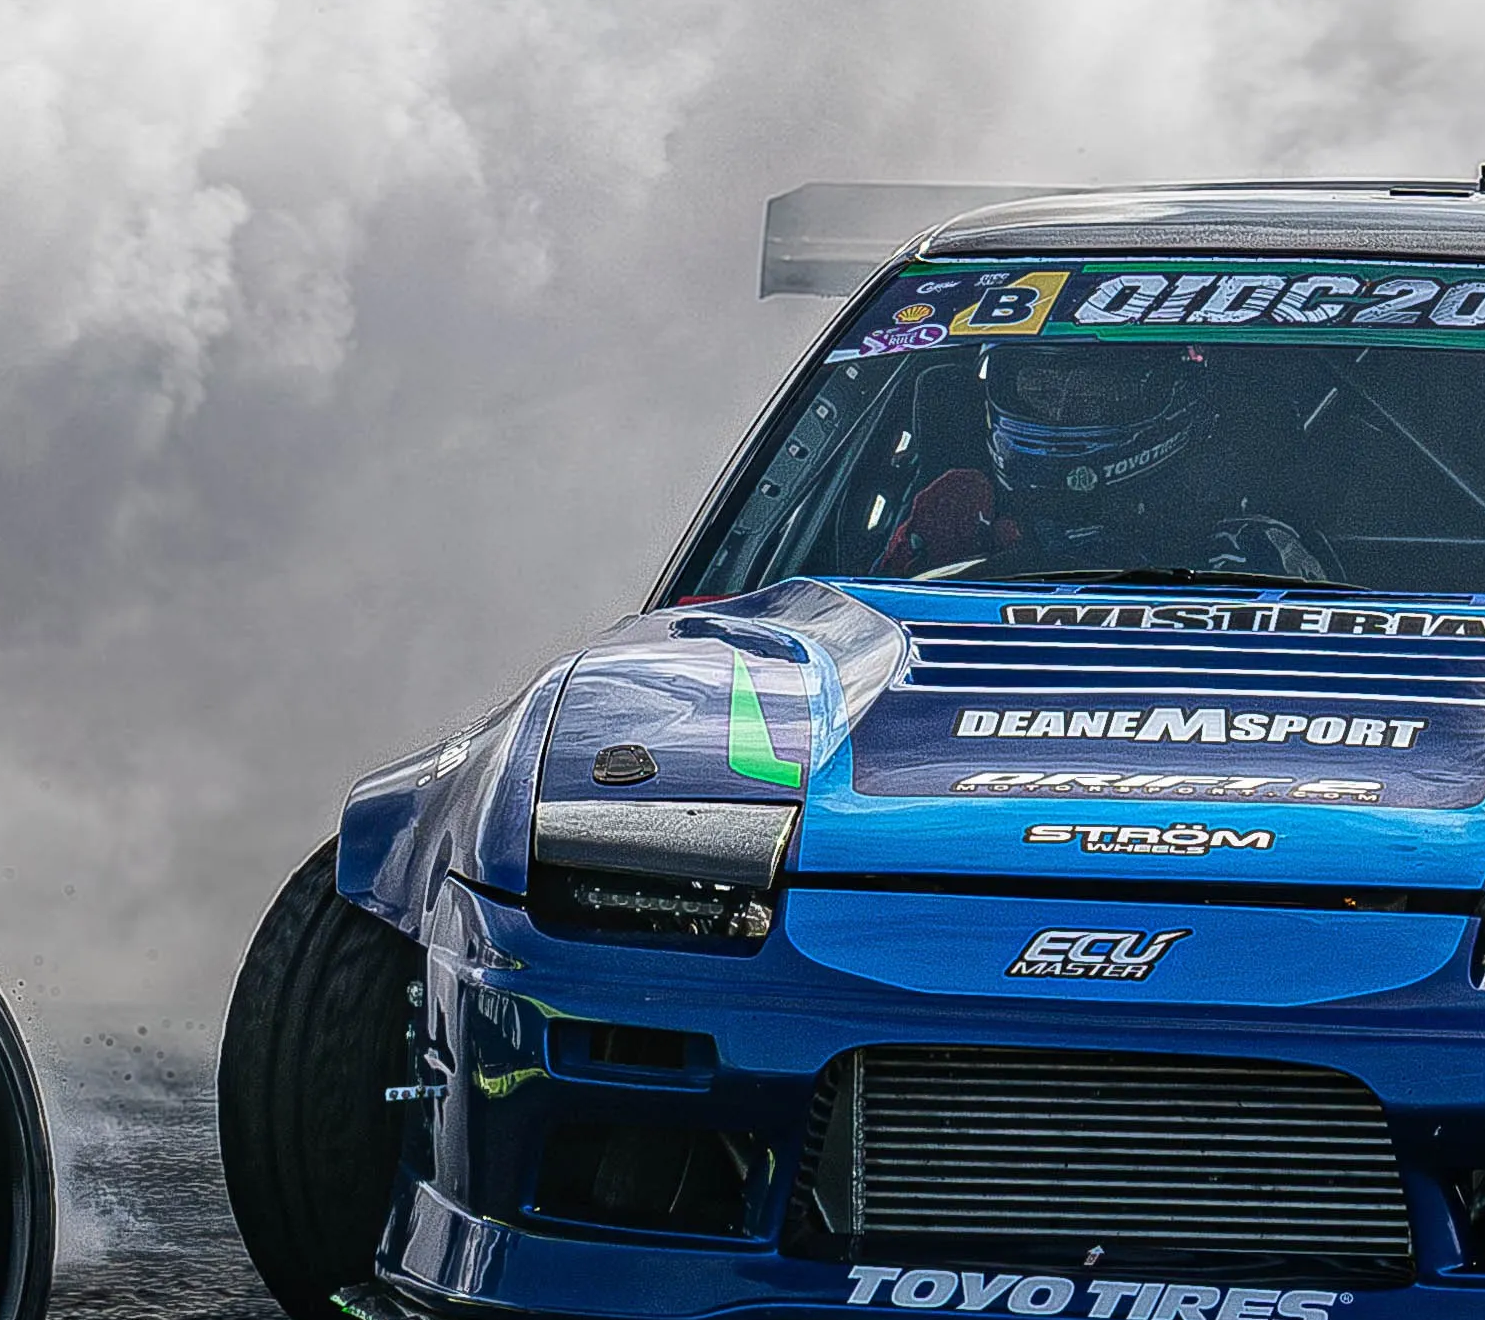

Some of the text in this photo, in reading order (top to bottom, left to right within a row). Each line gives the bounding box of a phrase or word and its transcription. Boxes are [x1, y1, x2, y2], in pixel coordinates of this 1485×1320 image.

[969, 287, 1040, 327] B
[1028, 823, 1272, 848] STRÖM
[1087, 842, 1205, 855] WHEELS
[1024, 930, 1188, 964] ECU
[1011, 962, 1149, 978] MASTER
[847, 1266, 1075, 1315] TOYO
